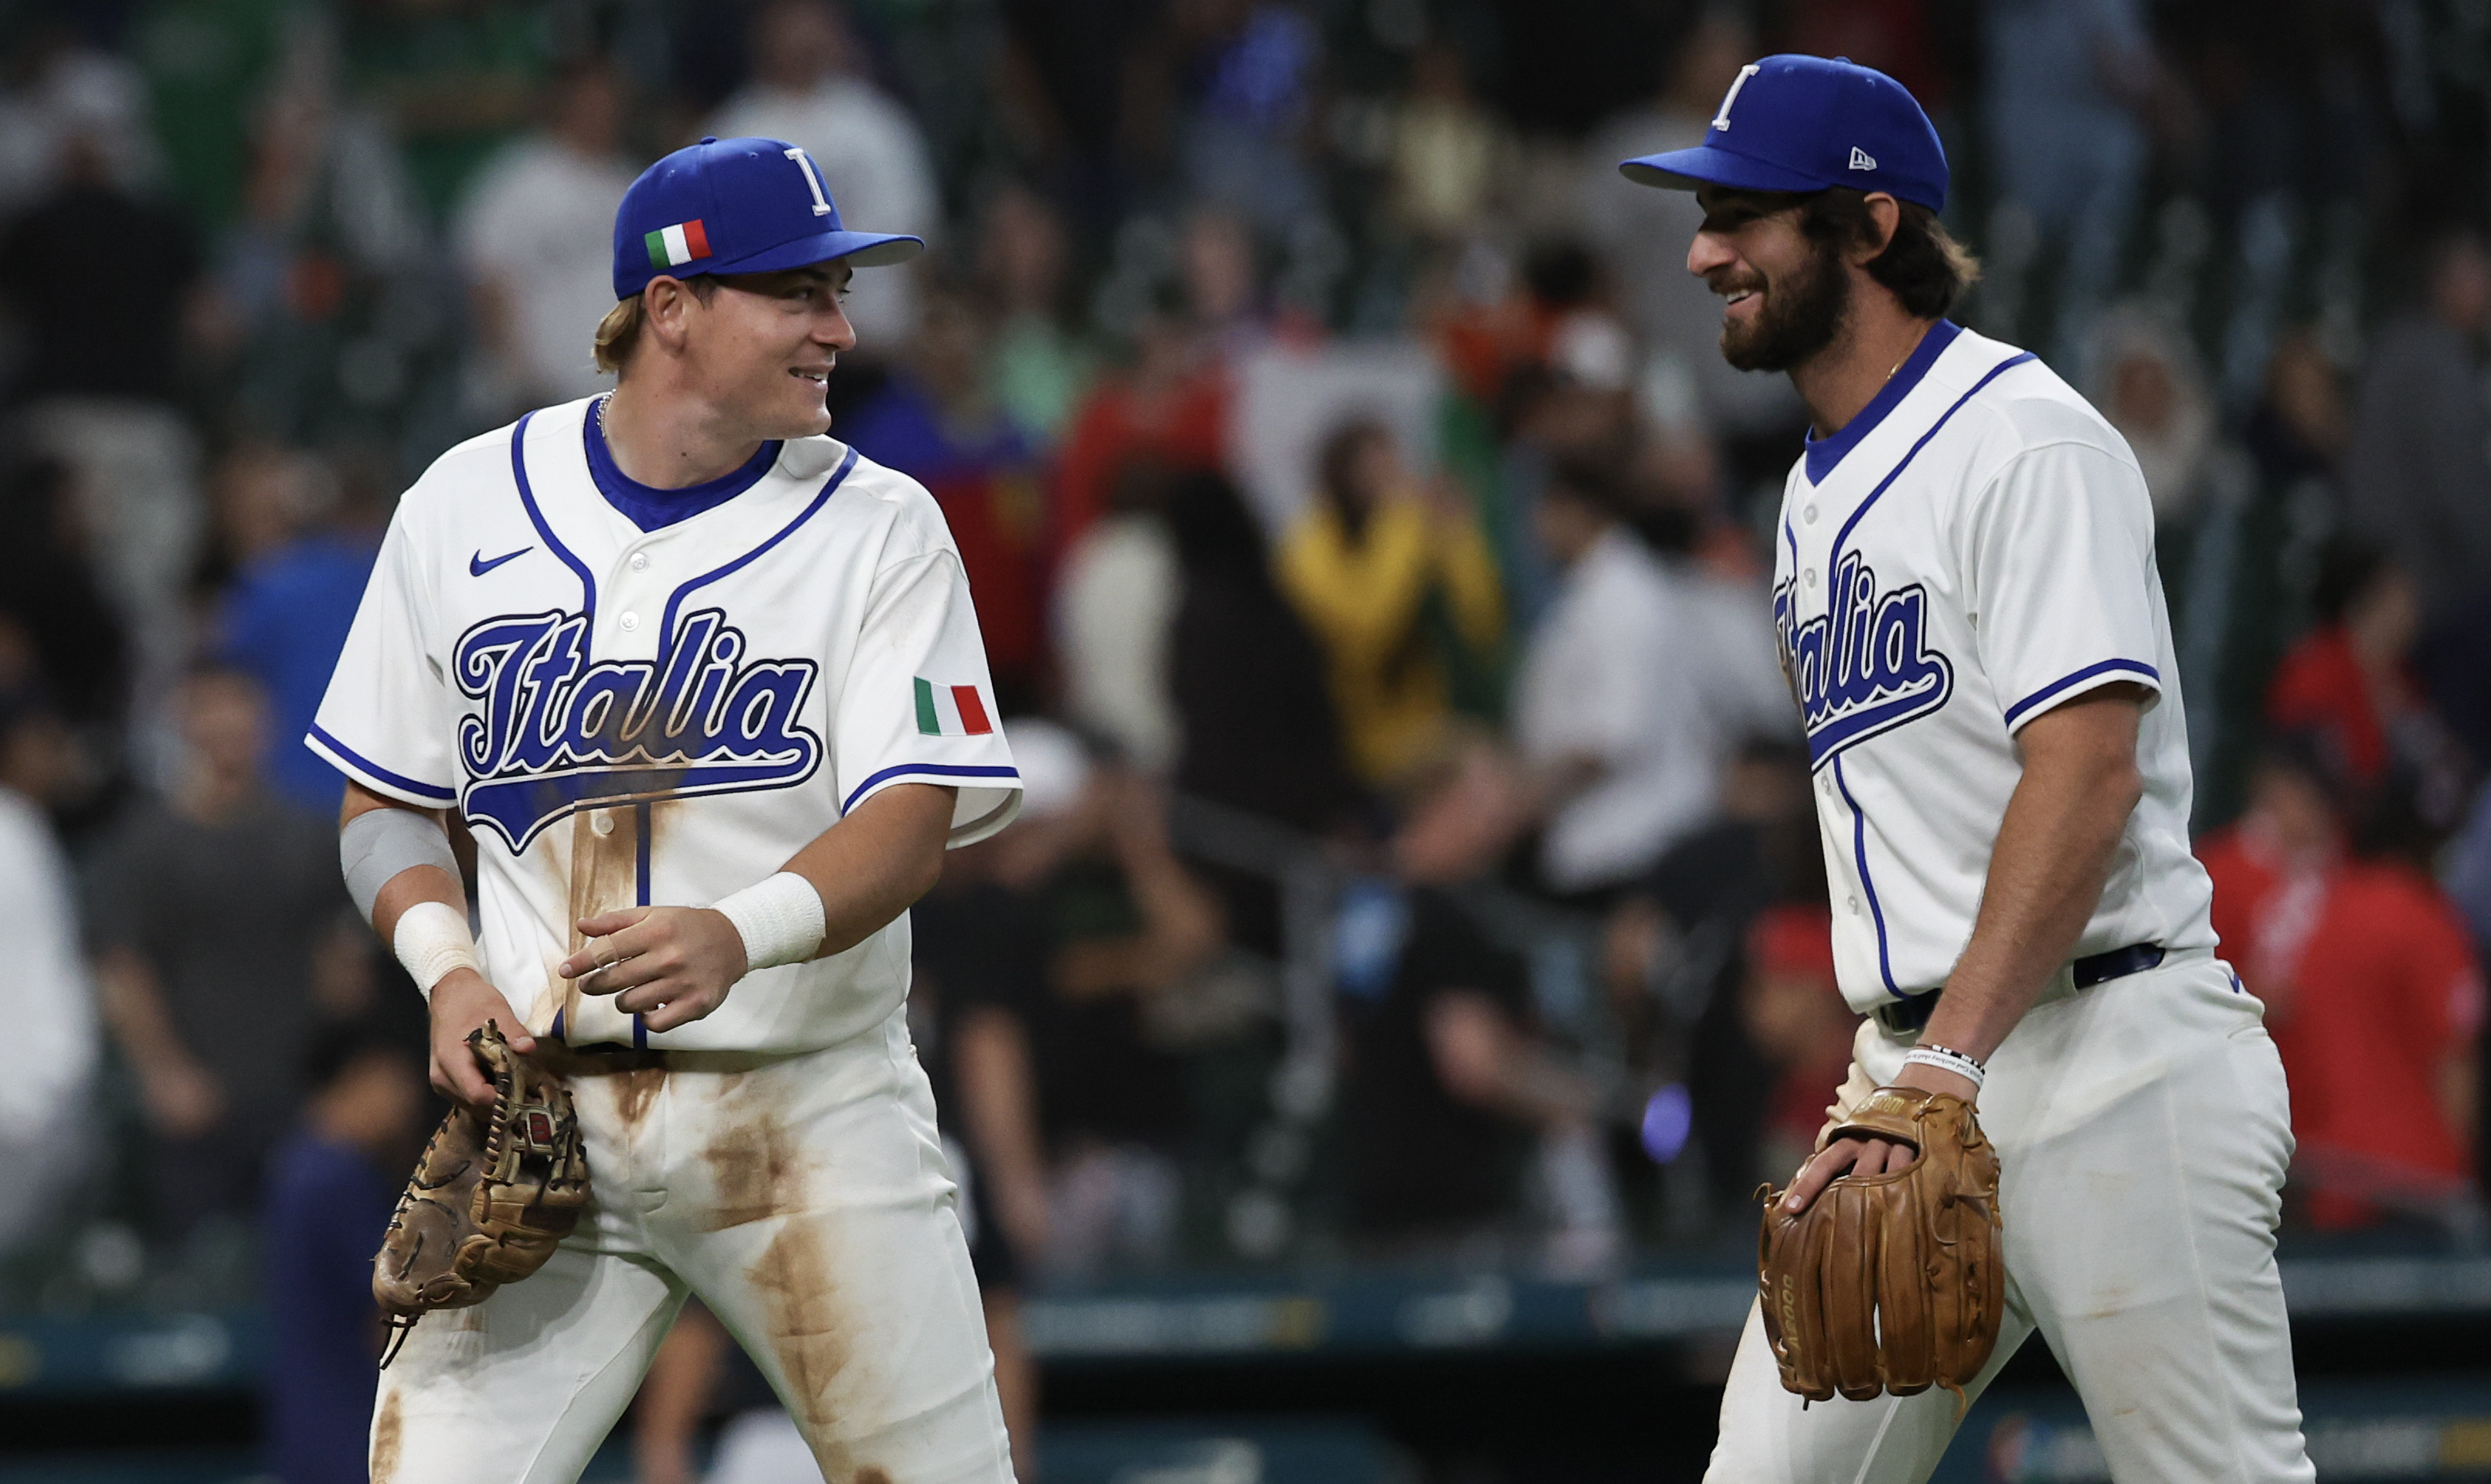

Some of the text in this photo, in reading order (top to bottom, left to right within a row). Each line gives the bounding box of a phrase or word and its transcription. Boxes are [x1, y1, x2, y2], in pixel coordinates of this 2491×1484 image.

[1711, 64, 1760, 131] I
[783, 148, 831, 217] I
[453, 607, 824, 856] Italia
